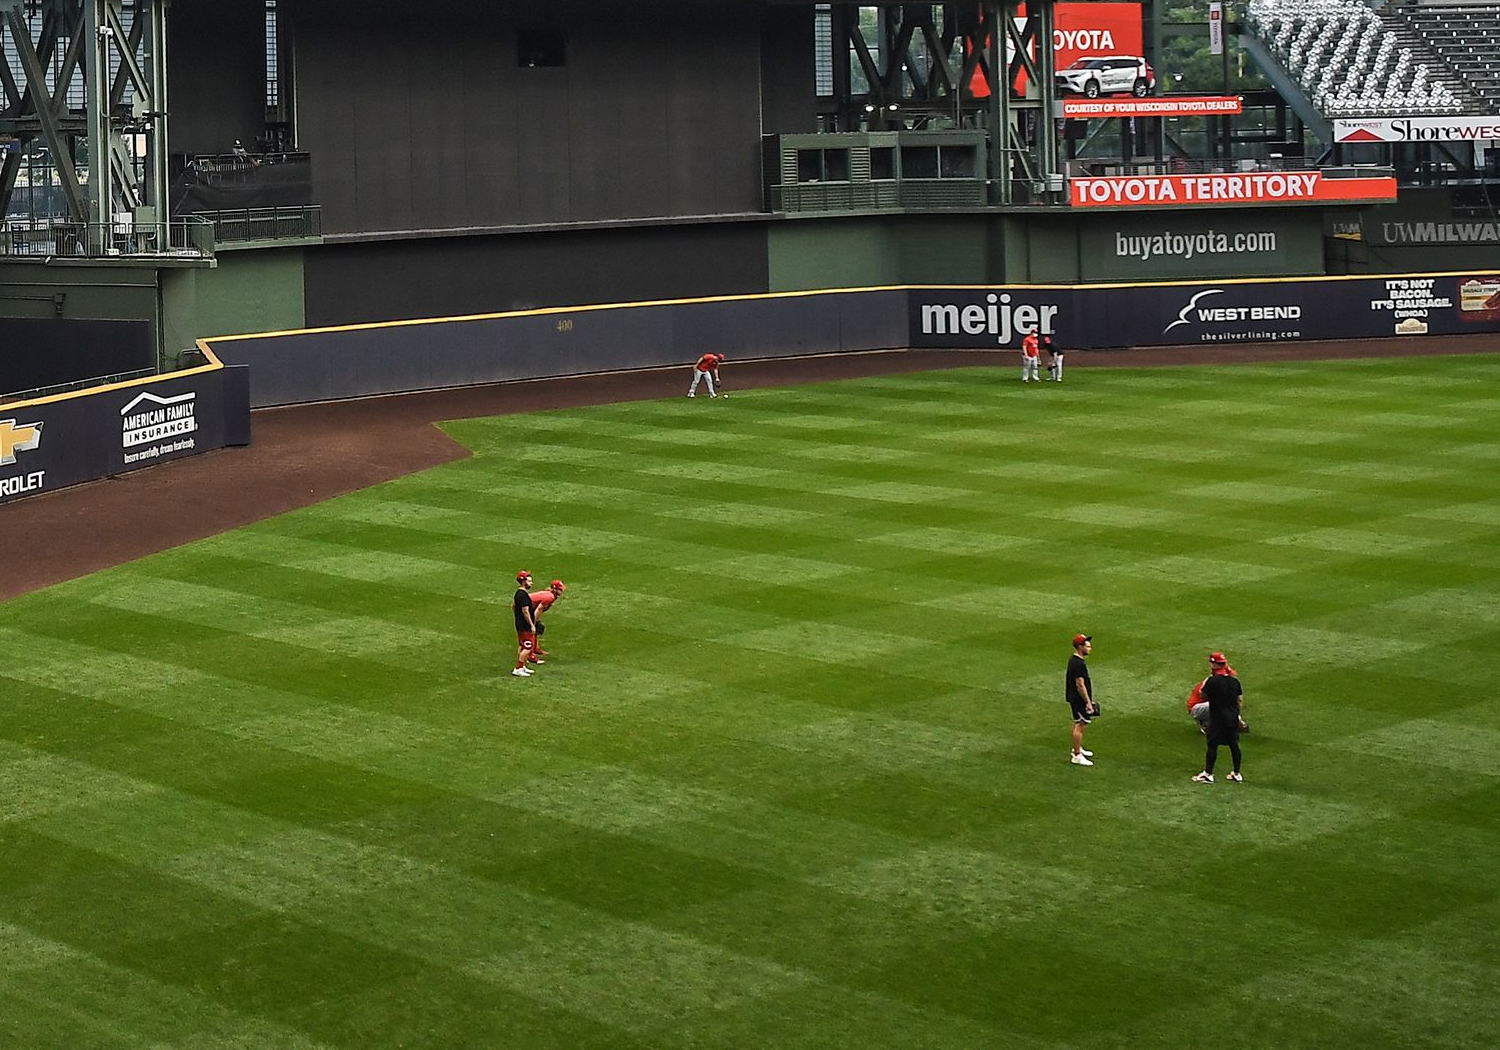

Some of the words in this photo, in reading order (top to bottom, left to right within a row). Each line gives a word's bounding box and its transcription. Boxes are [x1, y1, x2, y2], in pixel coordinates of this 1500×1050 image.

[1053, 29, 1115, 51] OYOTA
[1064, 103, 1104, 114] COURTESY
[1104, 103, 1116, 113] OF
[1115, 102, 1136, 112] YOUR
[1136, 102, 1179, 112] WISCONSIN
[1178, 101, 1208, 111] TOYOTA
[1207, 100, 1238, 110] DEALERS
[1074, 179, 1177, 203] TOYOTA
[1180, 174, 1319, 200] TERRITORY
[1115, 229, 1276, 261] buyatoyota.com
[1385, 279, 1409, 290] IT'S
[1410, 279, 1435, 289] NOT
[1389, 290, 1434, 299] BACON.
[1371, 300, 1395, 310] IT'S
[1395, 298, 1453, 309] SAUSAGE.
[921, 293, 1058, 344] meijer
[1198, 307, 1250, 321] WEST
[1250, 306, 1301, 320] BEND
[557, 319, 573, 332] 400
[123, 408, 165, 431] AMERICAN
[166, 401, 195, 421] FAMILY
[129, 420, 190, 443] INSURANCE
